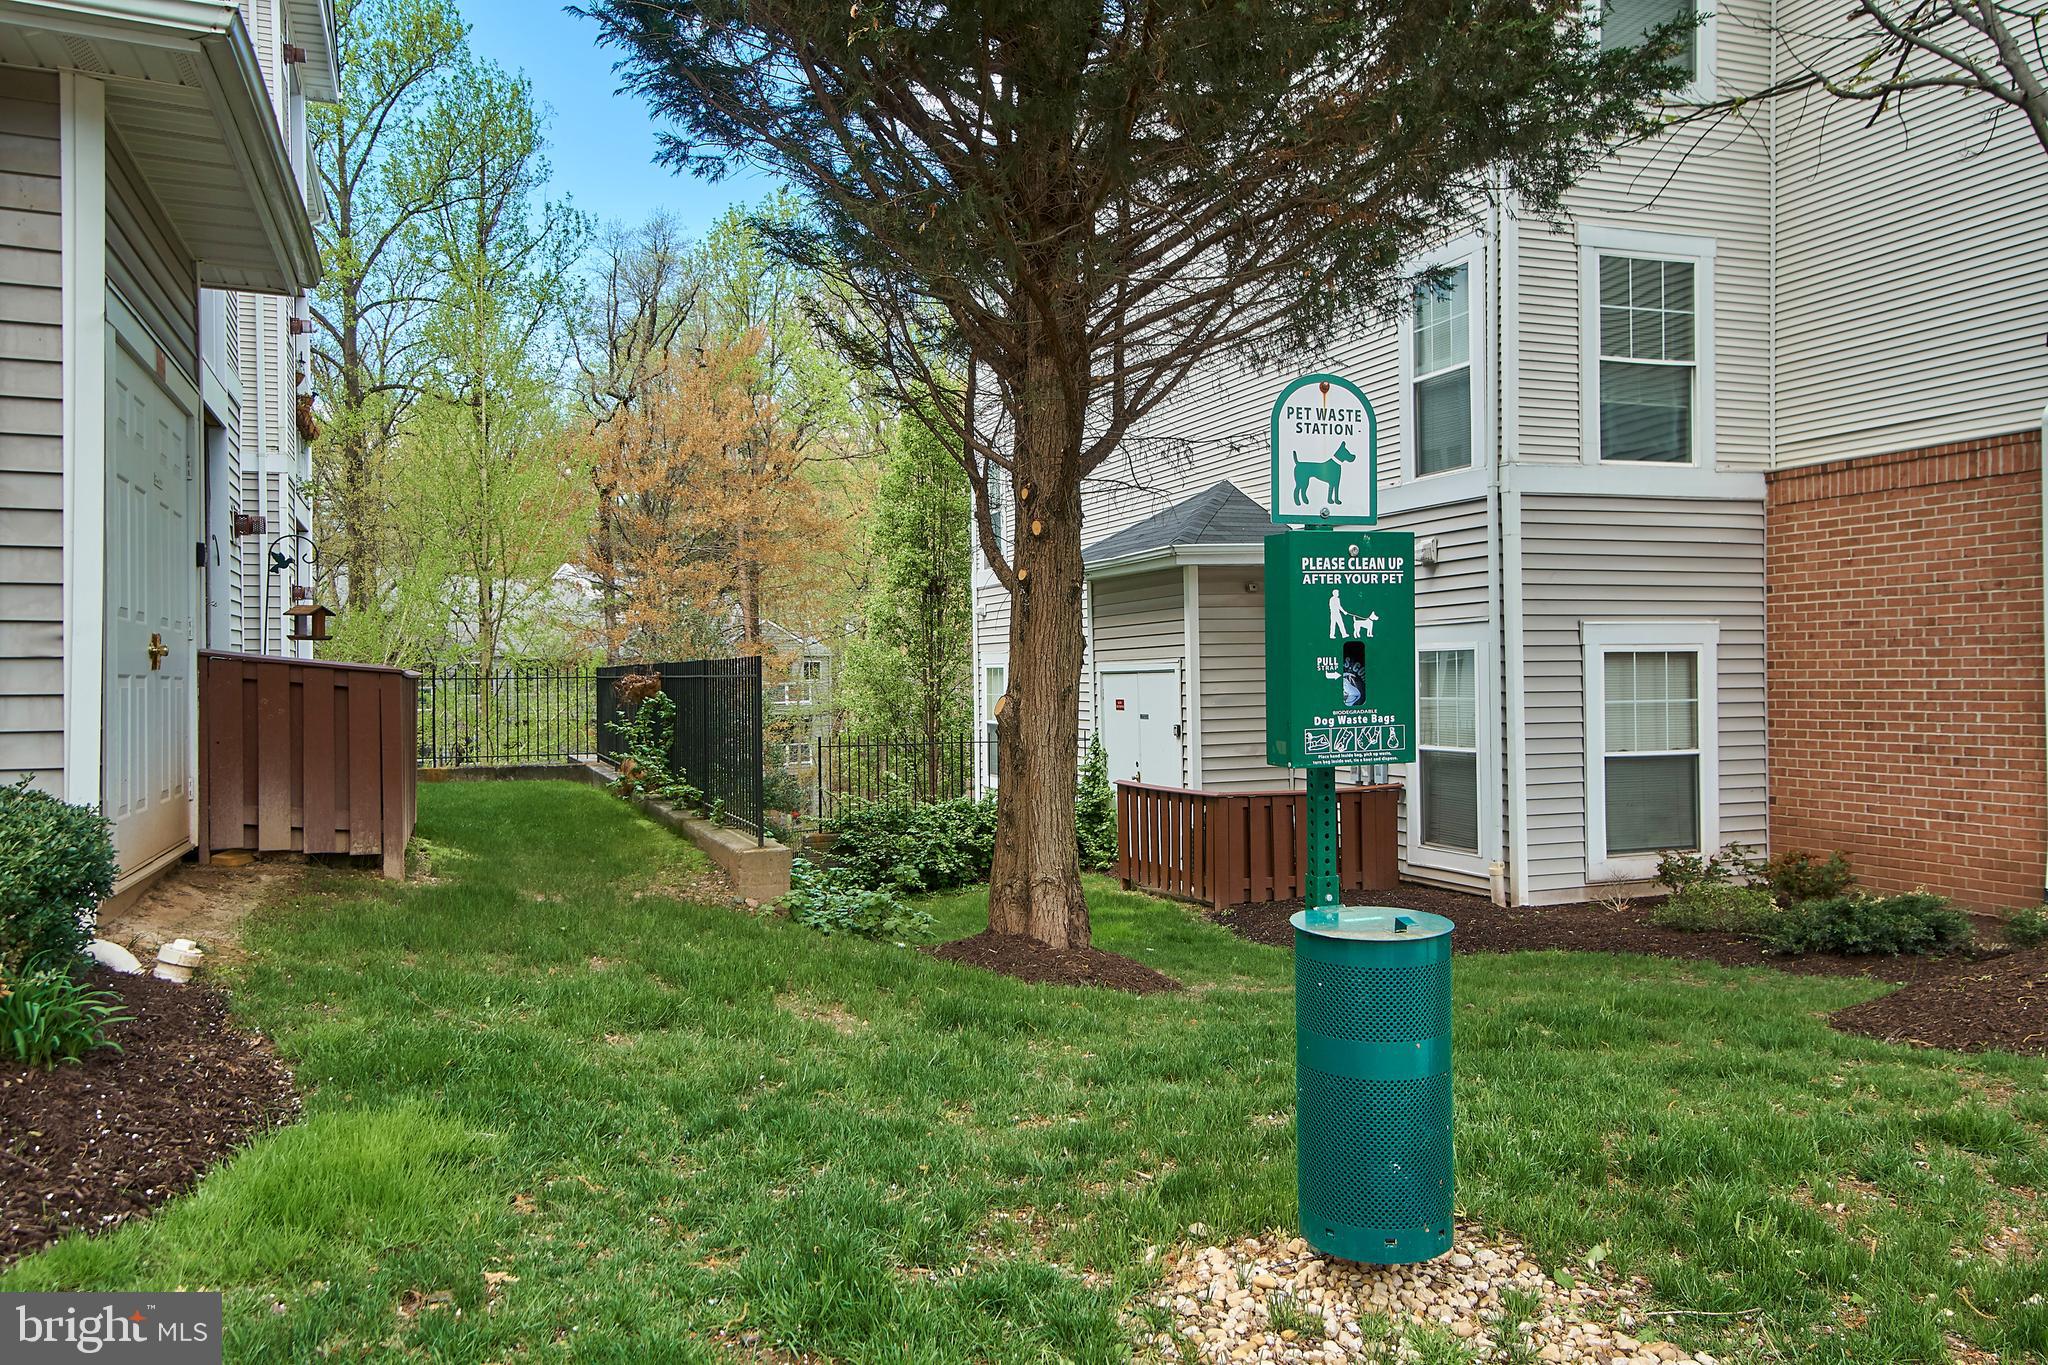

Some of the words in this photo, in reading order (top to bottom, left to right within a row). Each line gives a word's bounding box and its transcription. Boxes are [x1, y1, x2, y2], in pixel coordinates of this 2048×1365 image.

[1287, 406, 1311, 420] PET
[1316, 408, 1362, 422] WASTE
[1296, 422, 1353, 435] STATION
[1302, 557, 1345, 570] PLEASE
[1348, 557, 1385, 570] CLEAN
[1388, 557, 1404, 570] UP
[1303, 574, 1342, 584] AFTER
[1344, 574, 1378, 584] YOUR
[1381, 573, 1403, 584] PET
[1317, 657, 1338, 666] PULL
[1314, 716, 1335, 727] Dog
[1337, 715, 1368, 725] Waste
[1371, 714, 1395, 725] Bags
